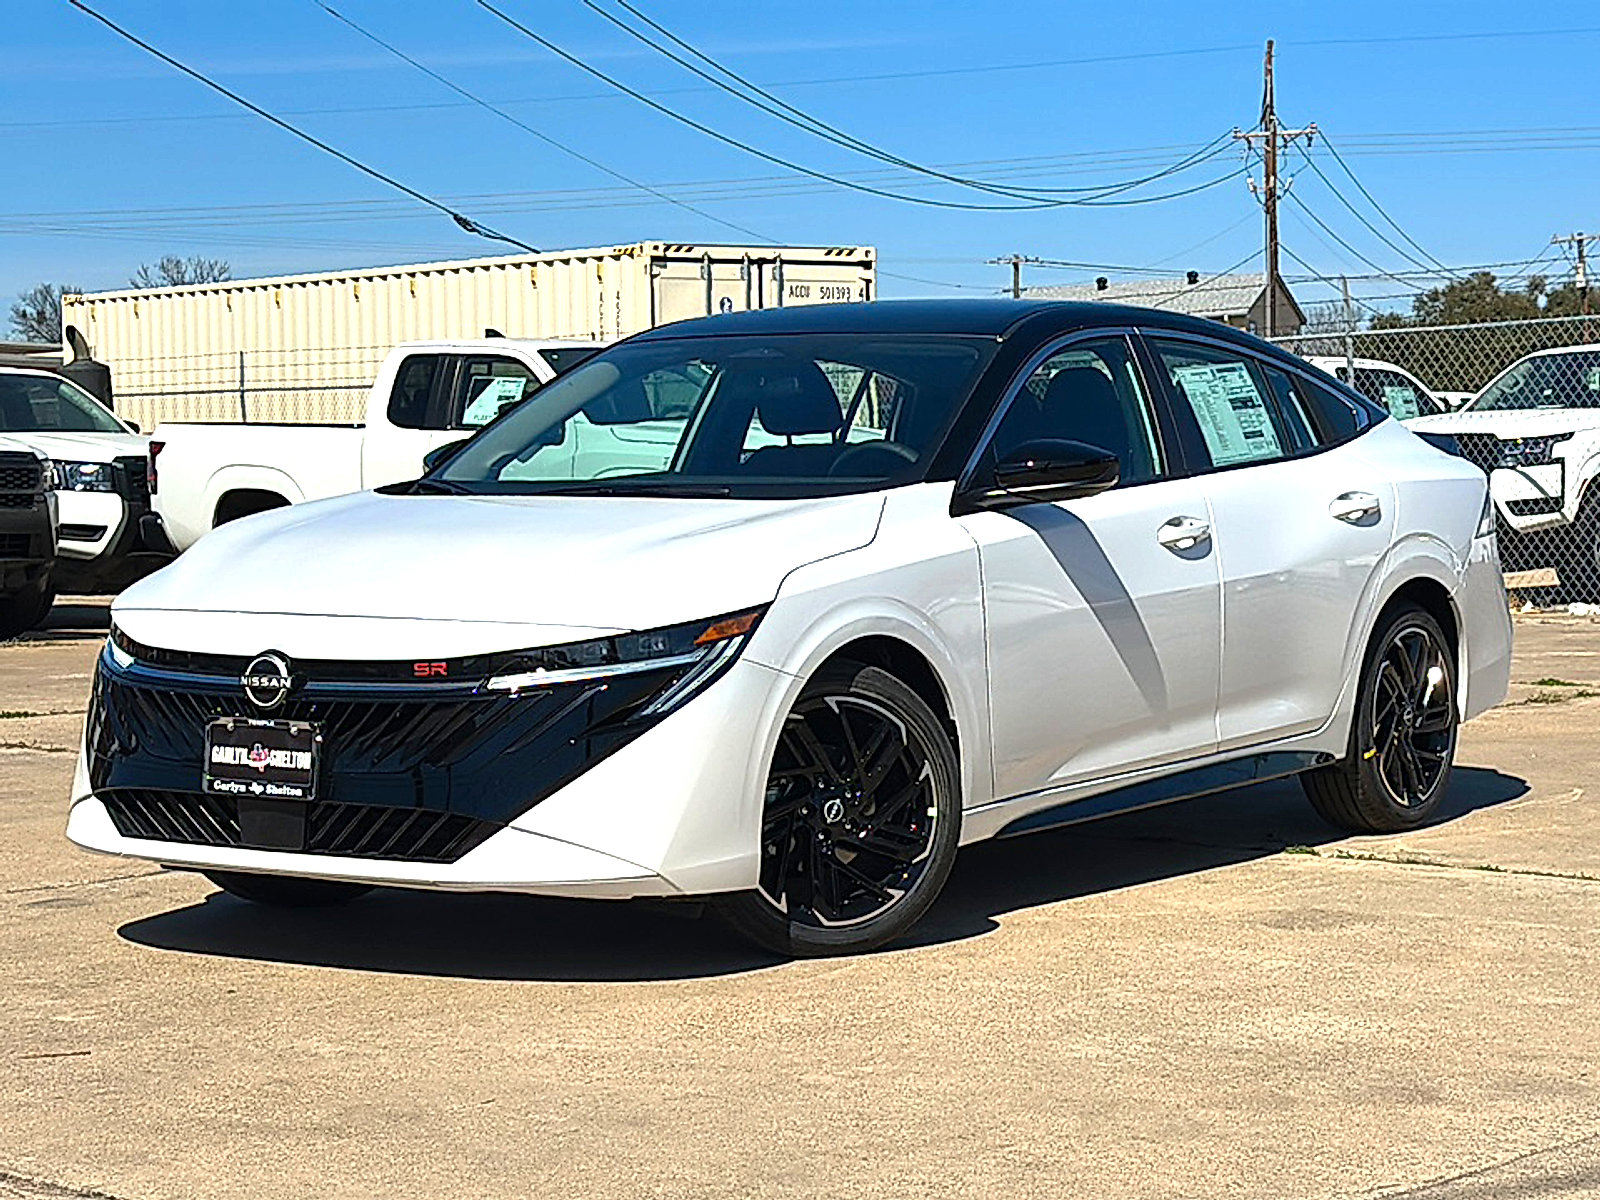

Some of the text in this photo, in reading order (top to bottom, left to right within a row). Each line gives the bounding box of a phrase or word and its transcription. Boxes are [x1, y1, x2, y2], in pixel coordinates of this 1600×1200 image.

[820, 286, 851, 300] 501393
[413, 662, 448, 677] SR
[240, 676, 292, 688] NISSAN
[269, 749, 312, 769] SHELTON
[265, 784, 303, 797] Shelton
